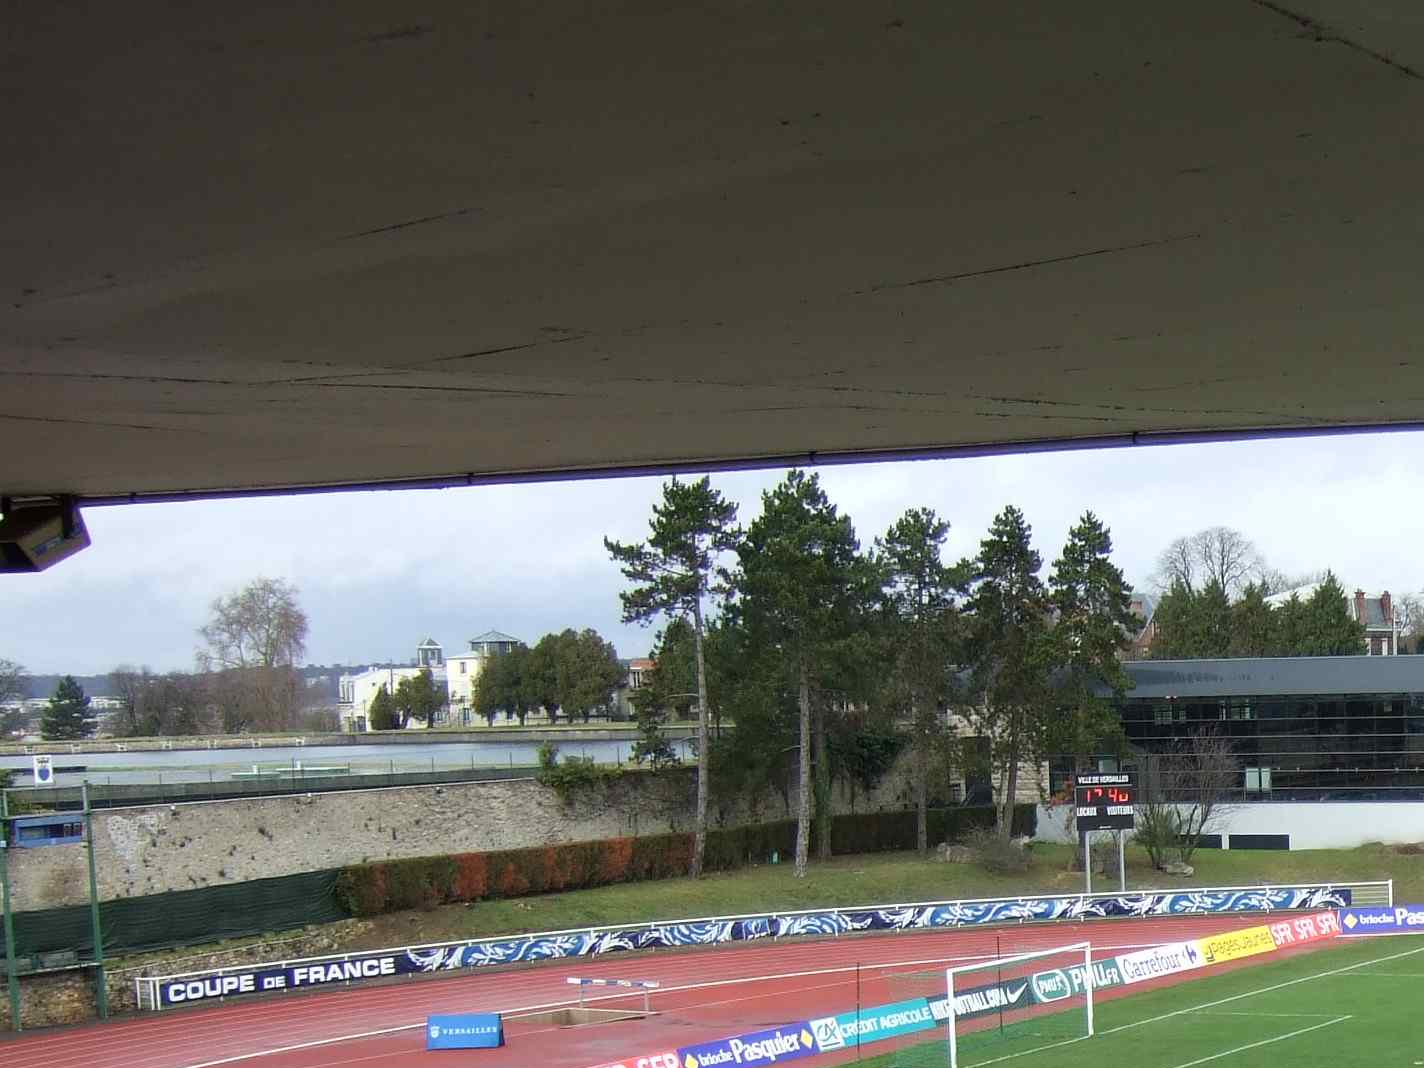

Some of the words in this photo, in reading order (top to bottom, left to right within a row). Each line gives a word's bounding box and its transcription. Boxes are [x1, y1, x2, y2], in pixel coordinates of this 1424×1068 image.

[1270, 922, 1296, 946] SFR
[1294, 917, 1318, 940] SFR
[1316, 911, 1340, 936] SFR
[1359, 914, 1395, 925] brioche
[168, 974, 256, 1003] COUPE
[263, 975, 287, 991] DE
[293, 957, 396, 987] FRANCE
[1122, 945, 1182, 980] Carrefour
[442, 1025, 498, 1036] VERSAILLES
[879, 1006, 933, 1030] AGRICOLE
[697, 1049, 735, 1068] brioche
[728, 1031, 801, 1064] Pasquier
